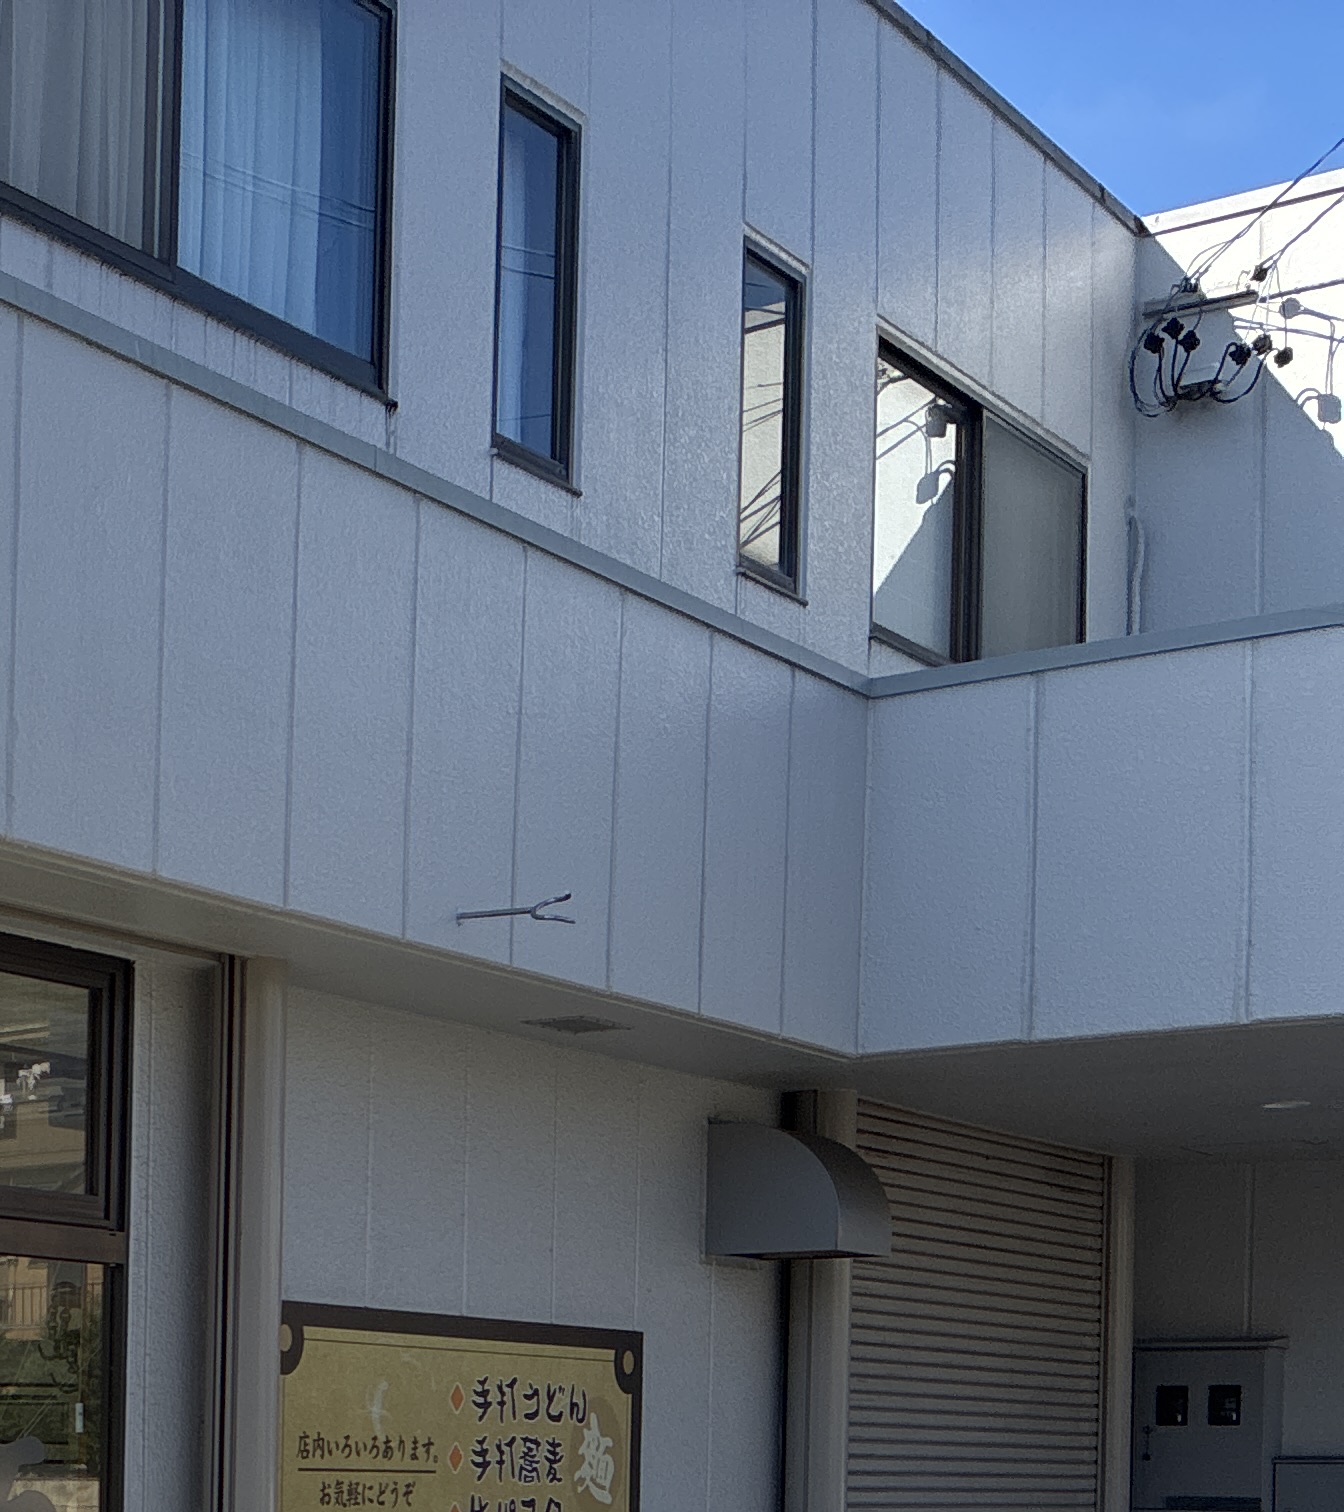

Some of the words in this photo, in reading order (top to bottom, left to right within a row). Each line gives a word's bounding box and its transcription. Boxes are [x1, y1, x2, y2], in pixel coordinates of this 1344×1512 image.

[471, 1375, 587, 1424] 手打うどん
[296, 1430, 439, 1465] 店内いろいろあります。
[470, 1435, 564, 1484] 手打蕎麦
[319, 1480, 417, 1509] お気軽にどうぞ
